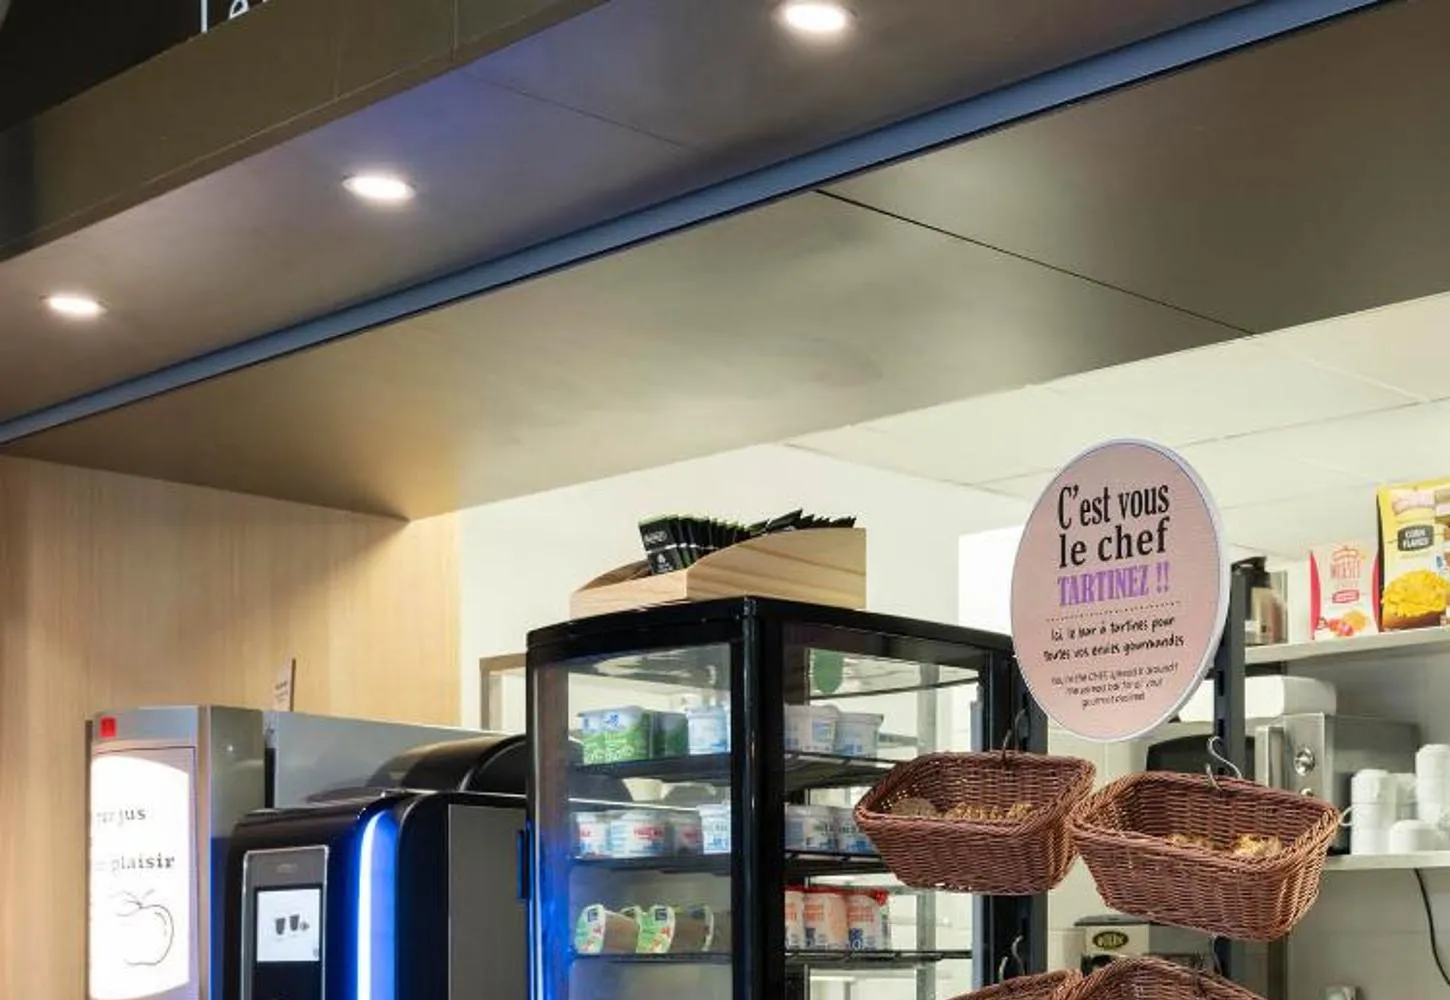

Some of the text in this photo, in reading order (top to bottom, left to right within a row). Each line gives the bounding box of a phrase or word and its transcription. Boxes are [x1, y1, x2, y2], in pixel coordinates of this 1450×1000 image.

[1058, 484, 1170, 530] C'est vous
[1059, 516, 1170, 569] le chef
[1057, 564, 1149, 607] TARTINEZ
[1110, 619, 1149, 635] tartines
[1151, 616, 1175, 633] pour
